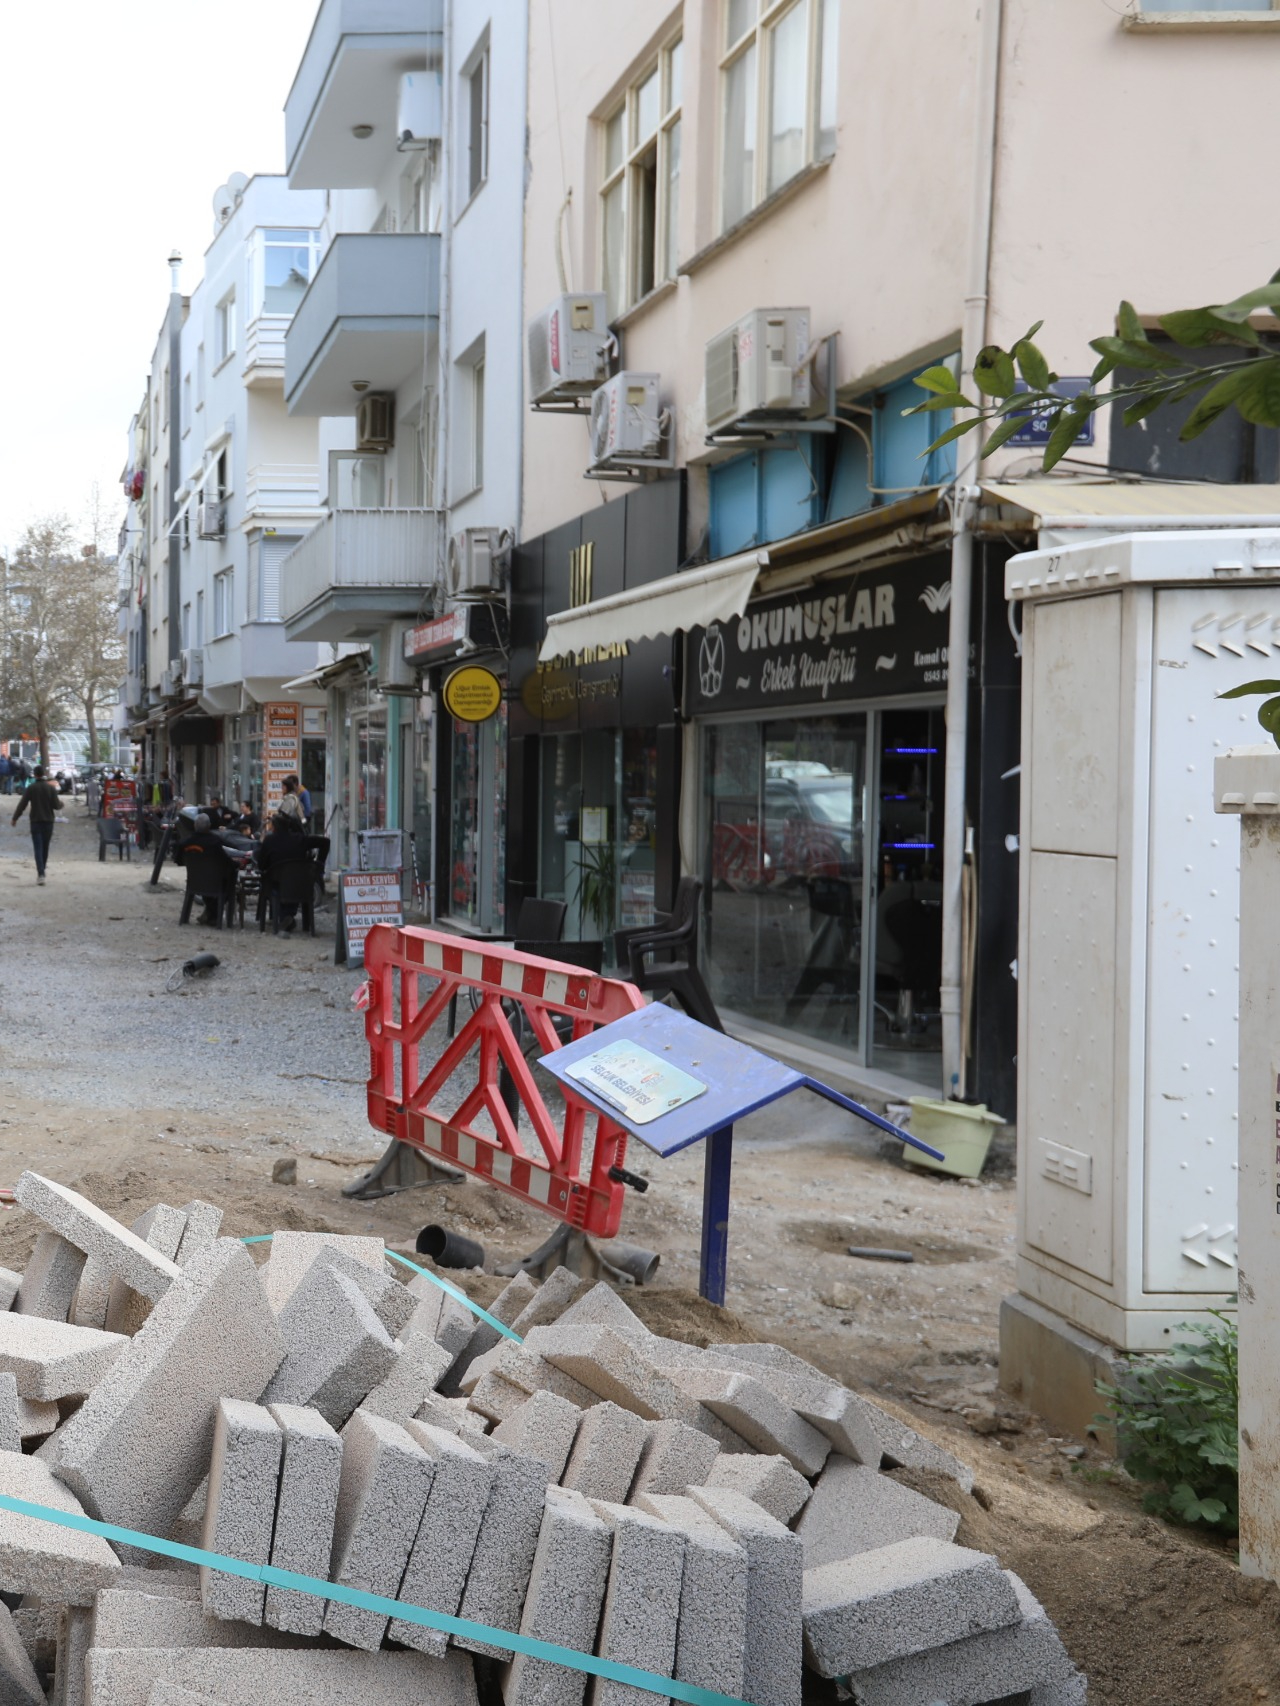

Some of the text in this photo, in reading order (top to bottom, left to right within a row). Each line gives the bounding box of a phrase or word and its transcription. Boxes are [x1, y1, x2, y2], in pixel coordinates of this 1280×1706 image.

[1048, 556, 1061, 573] 27
[737, 583, 896, 653] OKUMUŞLAR
[914, 646, 940, 667] Kemal
[760, 645, 857, 700] Erkek Kuaförü
[611, 1077, 656, 1106] BELEDİYESİ
